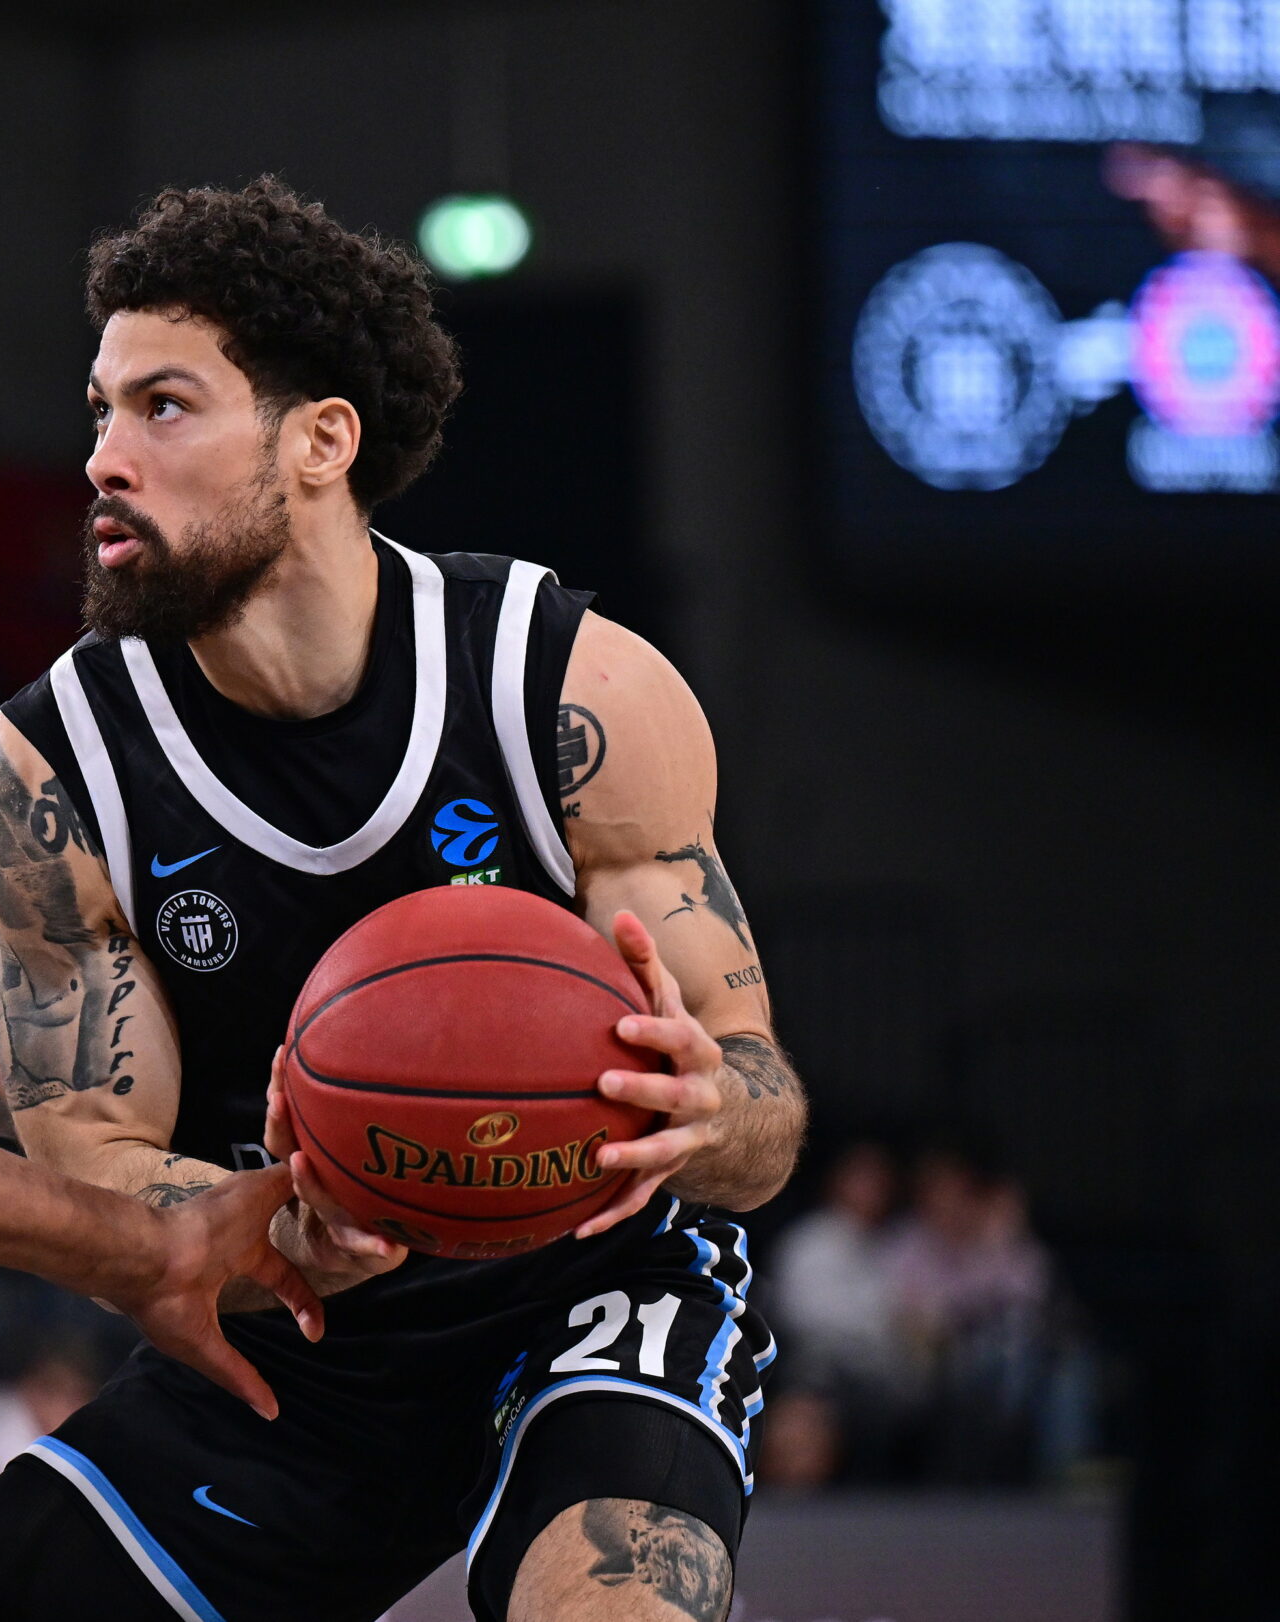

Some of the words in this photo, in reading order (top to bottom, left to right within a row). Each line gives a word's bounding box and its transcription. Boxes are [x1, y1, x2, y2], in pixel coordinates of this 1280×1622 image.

[160, 897, 188, 932] VEOLIA
[192, 894, 232, 929] TOWERS
[180, 952, 225, 967] HAMBURG
[723, 964, 762, 989] EXOD
[549, 1290, 682, 1377] 21
[494, 1386, 518, 1431] BKT
